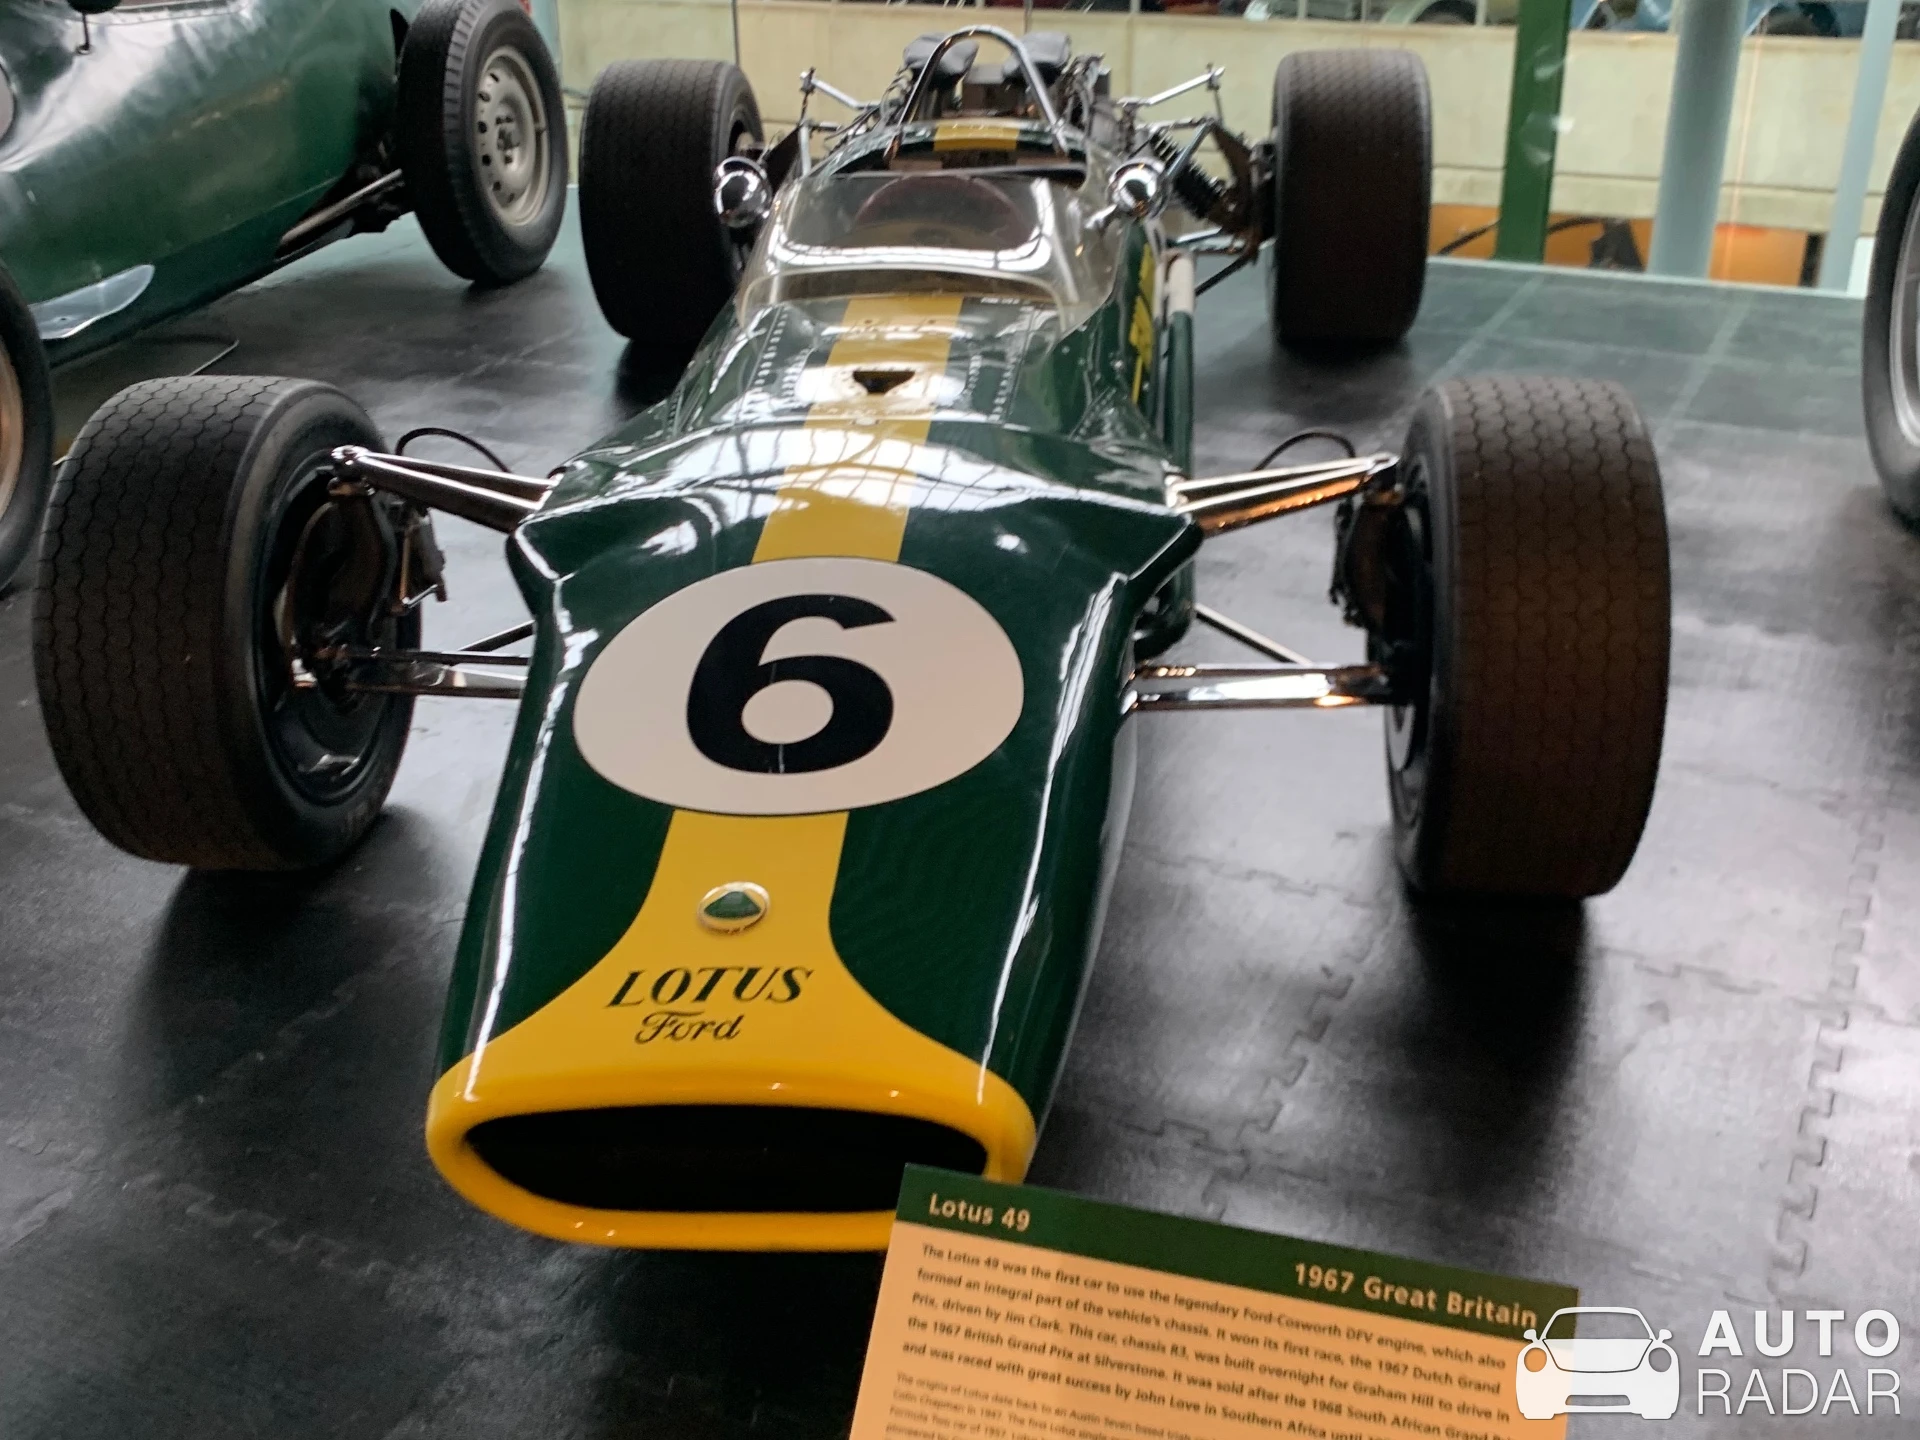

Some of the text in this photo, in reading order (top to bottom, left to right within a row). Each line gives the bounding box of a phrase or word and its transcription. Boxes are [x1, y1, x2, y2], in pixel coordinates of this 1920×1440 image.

[685, 592, 897, 774] 6
[602, 966, 815, 1010] LOTUS
[634, 1010, 745, 1044] Ford
[929, 1192, 1031, 1232] Lotus 49
[917, 1267, 963, 1288] formed
[965, 1280, 980, 1291] an
[984, 1281, 1033, 1301] integral
[1035, 1293, 1062, 1309] part
[1065, 1298, 1079, 1310] of
[1083, 1300, 1103, 1316] the
[1216, 1327, 1226, 1340] It
[1230, 1331, 1259, 1347] won
[1263, 1336, 1278, 1351] its
[1283, 1340, 1310, 1358] first
[1350, 1353, 1372, 1370] the
[1378, 1359, 1409, 1376] 1967
[1413, 1366, 1453, 1386] Dutch
[1457, 1375, 1501, 1395] Grand
[922, 1242, 944, 1259] The
[947, 1249, 980, 1267] Lotus
[984, 1256, 1000, 1269] 49
[1003, 1262, 1027, 1276] was
[1031, 1266, 1051, 1280] the
[1055, 1268, 1080, 1286] first
[1083, 1277, 1103, 1290] car
[1106, 1281, 1120, 1294] to
[1124, 1284, 1145, 1298] use
[1149, 1288, 1170, 1303] the
[1173, 1292, 1239, 1320] legendary
[1432, 1345, 1473, 1364] which
[1478, 1353, 1506, 1370] also
[1295, 1262, 1538, 1329] 1967 Great Britain
[902, 1342, 927, 1356] and
[930, 1347, 954, 1361] was
[958, 1353, 992, 1370] raced
[995, 1361, 1024, 1377] with
[1028, 1368, 1062, 1385] great
[1065, 1374, 1111, 1395] success
[1115, 1383, 1131, 1401] by
[1135, 1388, 1166, 1405] John
[1169, 1395, 1201, 1413] Love
[1204, 1401, 1217, 1416] in
[1221, 1405, 1282, 1430] Southern
[1287, 1420, 1327, 1439] Africa
[908, 1316, 928, 1331] the
[933, 1321, 961, 1336] 1967
[964, 1327, 1003, 1347] British
[1007, 1334, 1046, 1355] Grand
[1049, 1344, 1073, 1360] Prix
[1077, 1352, 1090, 1364] at
[1173, 1369, 1182, 1382] It
[1186, 1374, 1213, 1389] was
[1216, 1380, 1244, 1396] sold
[1248, 1385, 1279, 1402] after
[1284, 1392, 1306, 1408] the
[1347, 1405, 1386, 1426] South
[1391, 1415, 1441, 1436] African
[942, 1298, 982, 1316] driven
[985, 1306, 1001, 1324] by
[1005, 1310, 1025, 1325] Jim
[1069, 1322, 1093, 1340] This
[1122, 1334, 1166, 1354] chassis
[1194, 1350, 1220, 1365] was
[1224, 1353, 1255, 1372] built
[1258, 1363, 1324, 1386] overnight
[1329, 1374, 1348, 1391] for
[1352, 1380, 1407, 1402] Graham
[1411, 1392, 1434, 1409] Hill
[1438, 1398, 1453, 1412] to
[1457, 1401, 1492, 1419] drive
[1496, 1408, 1510, 1424] in
